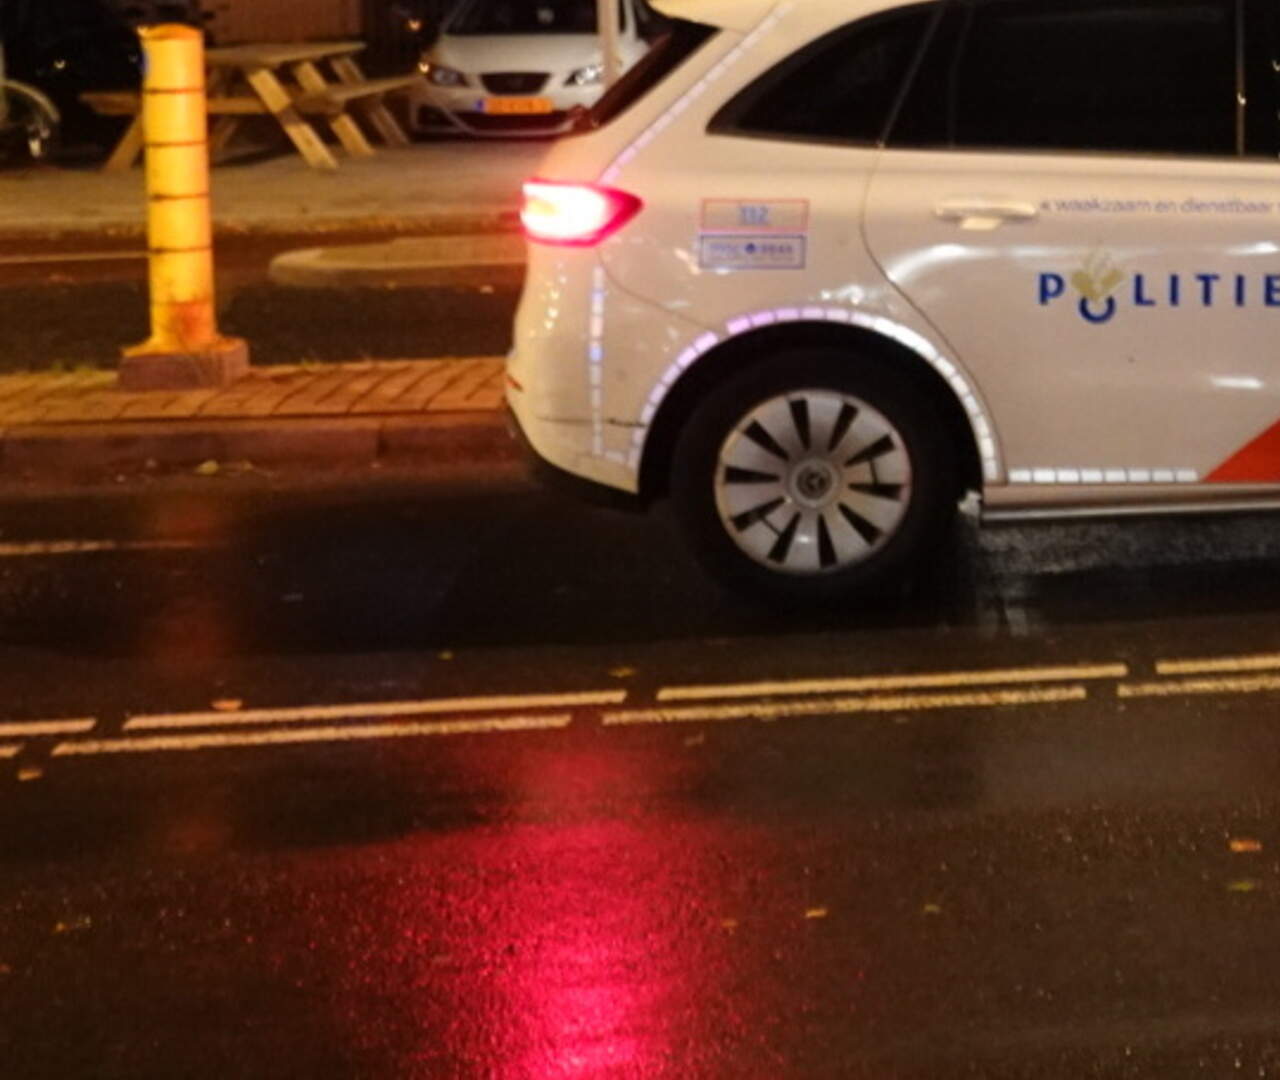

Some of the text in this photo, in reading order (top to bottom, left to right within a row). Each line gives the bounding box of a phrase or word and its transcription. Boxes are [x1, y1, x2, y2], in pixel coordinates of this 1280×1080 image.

[1056, 195, 1152, 213] waakzaam
[1154, 199, 1176, 213] en
[1180, 195, 1272, 213] dienstbaar
